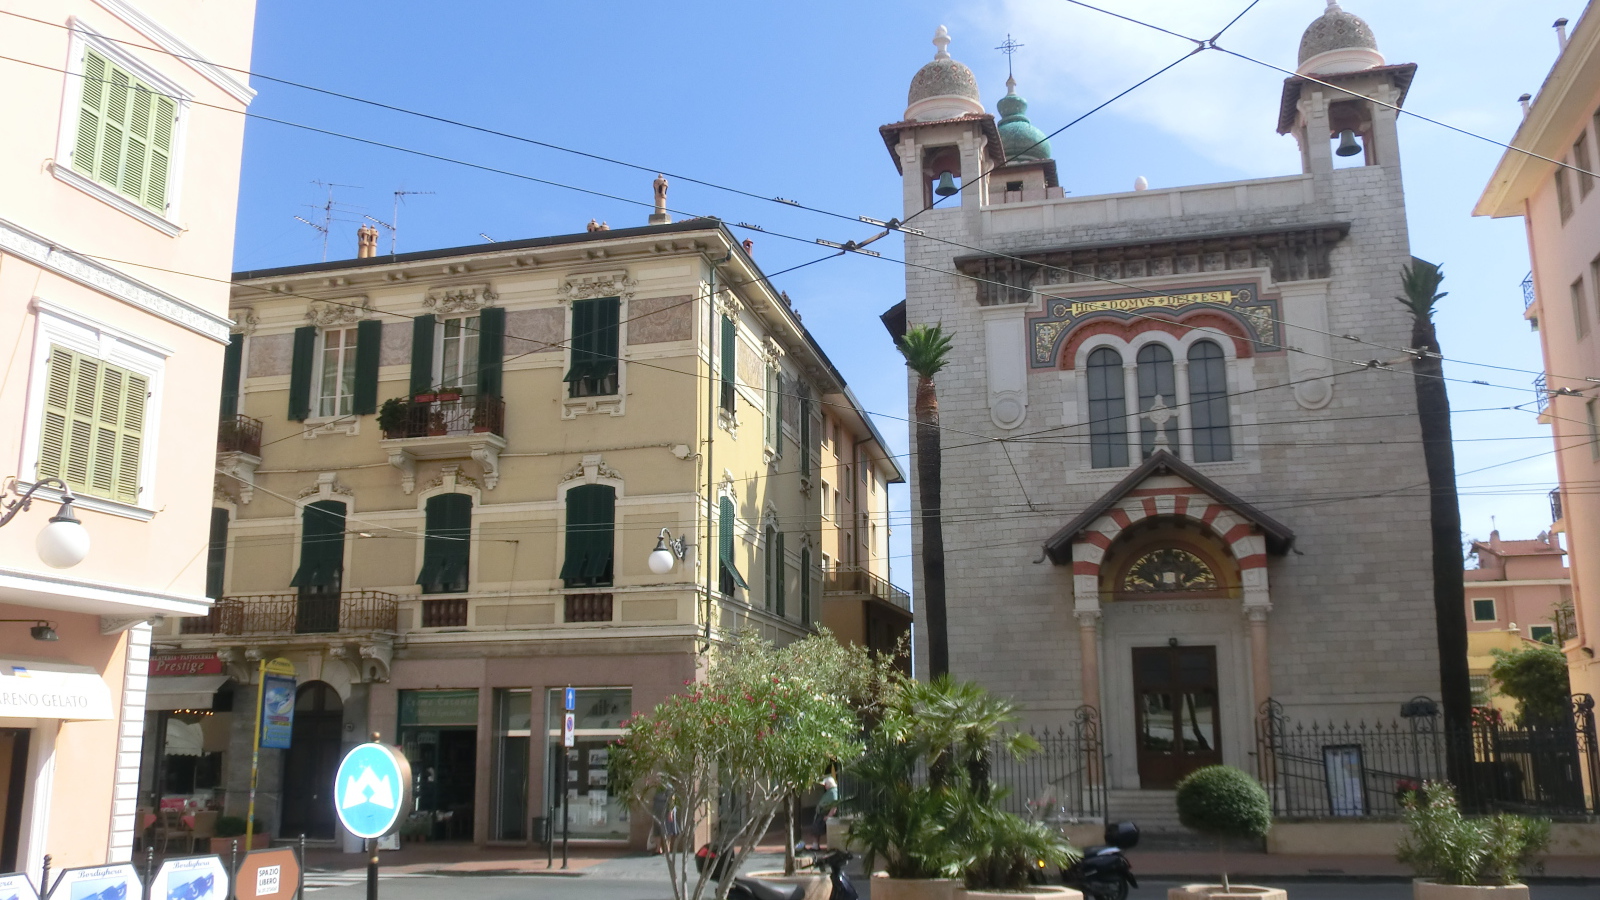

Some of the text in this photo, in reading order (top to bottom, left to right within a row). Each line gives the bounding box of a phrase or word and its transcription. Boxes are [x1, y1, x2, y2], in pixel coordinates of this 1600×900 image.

[1110, 297, 1155, 310] DOMVS
[1167, 295, 1190, 305] DEI
[1201, 292, 1227, 301] EST
[155, 660, 205, 673] Prestige
[41, 693, 88, 708] GELATO
[173, 860, 210, 869] Bordighera
[77, 868, 123, 878] Bordighera
[259, 867, 279, 877] SPAZIO
[259, 877, 278, 887] LIBERO
